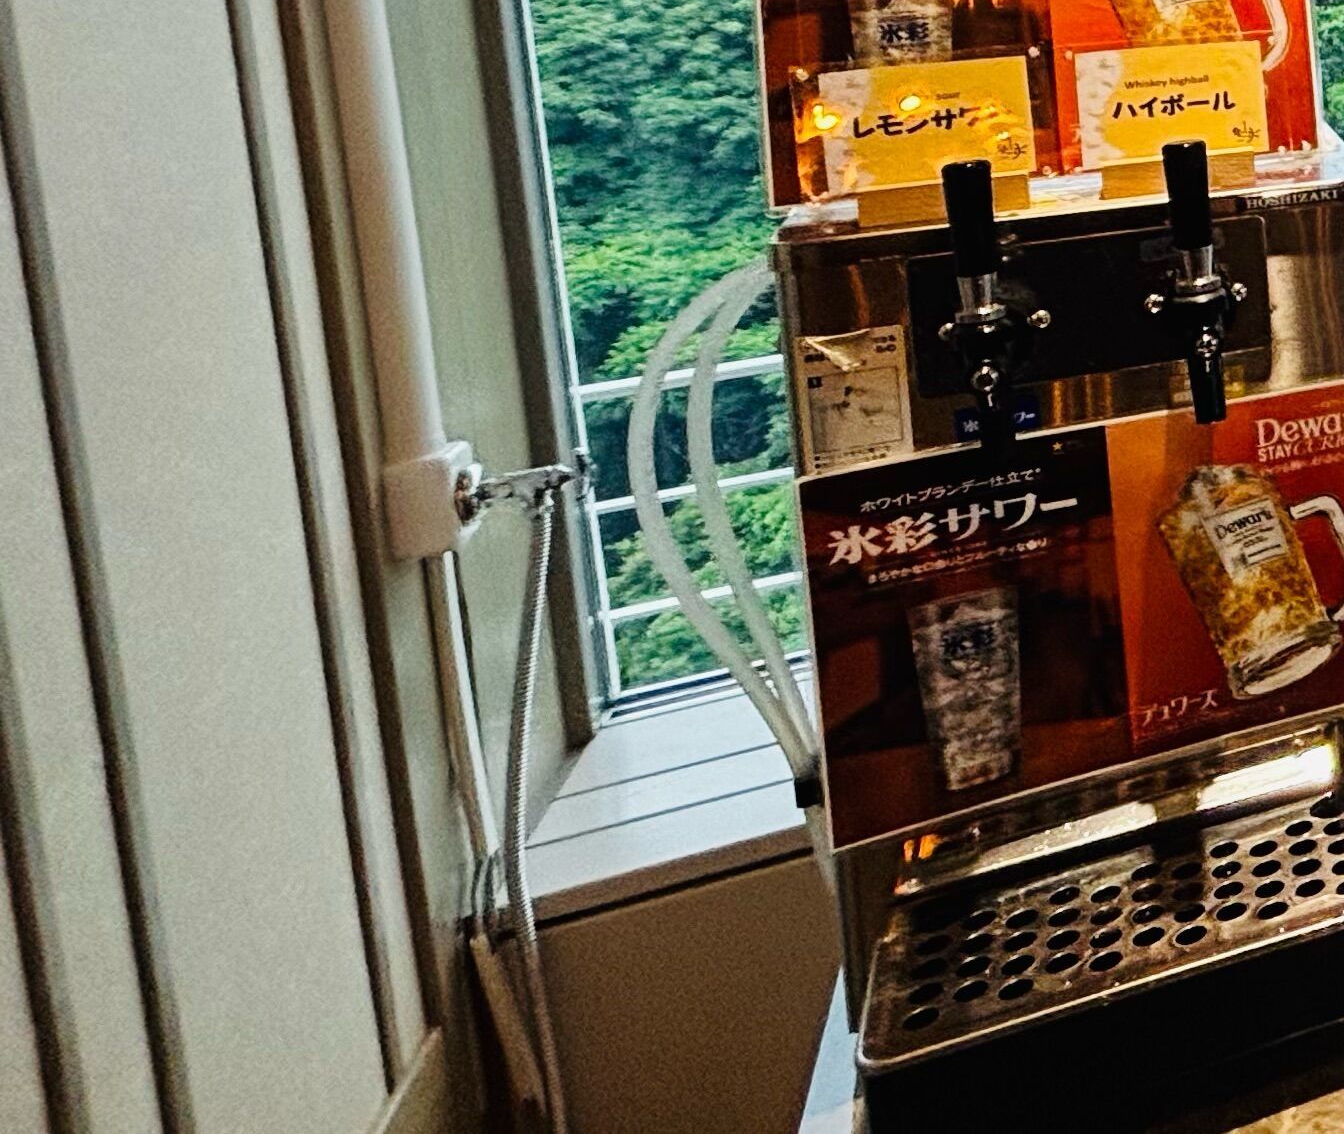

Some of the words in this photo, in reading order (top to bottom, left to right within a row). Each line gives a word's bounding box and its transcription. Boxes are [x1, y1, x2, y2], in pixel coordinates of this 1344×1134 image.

[1124, 78, 1167, 90] Whiskey
[1170, 74, 1209, 88] highball
[1112, 91, 1236, 118] ハイボール
[853, 104, 1002, 139] レモンサワ
[1246, 188, 1339, 211] HOSHIZAKI
[1257, 444, 1292, 462] STAY
[828, 492, 1079, 567] 氷彩サワー
